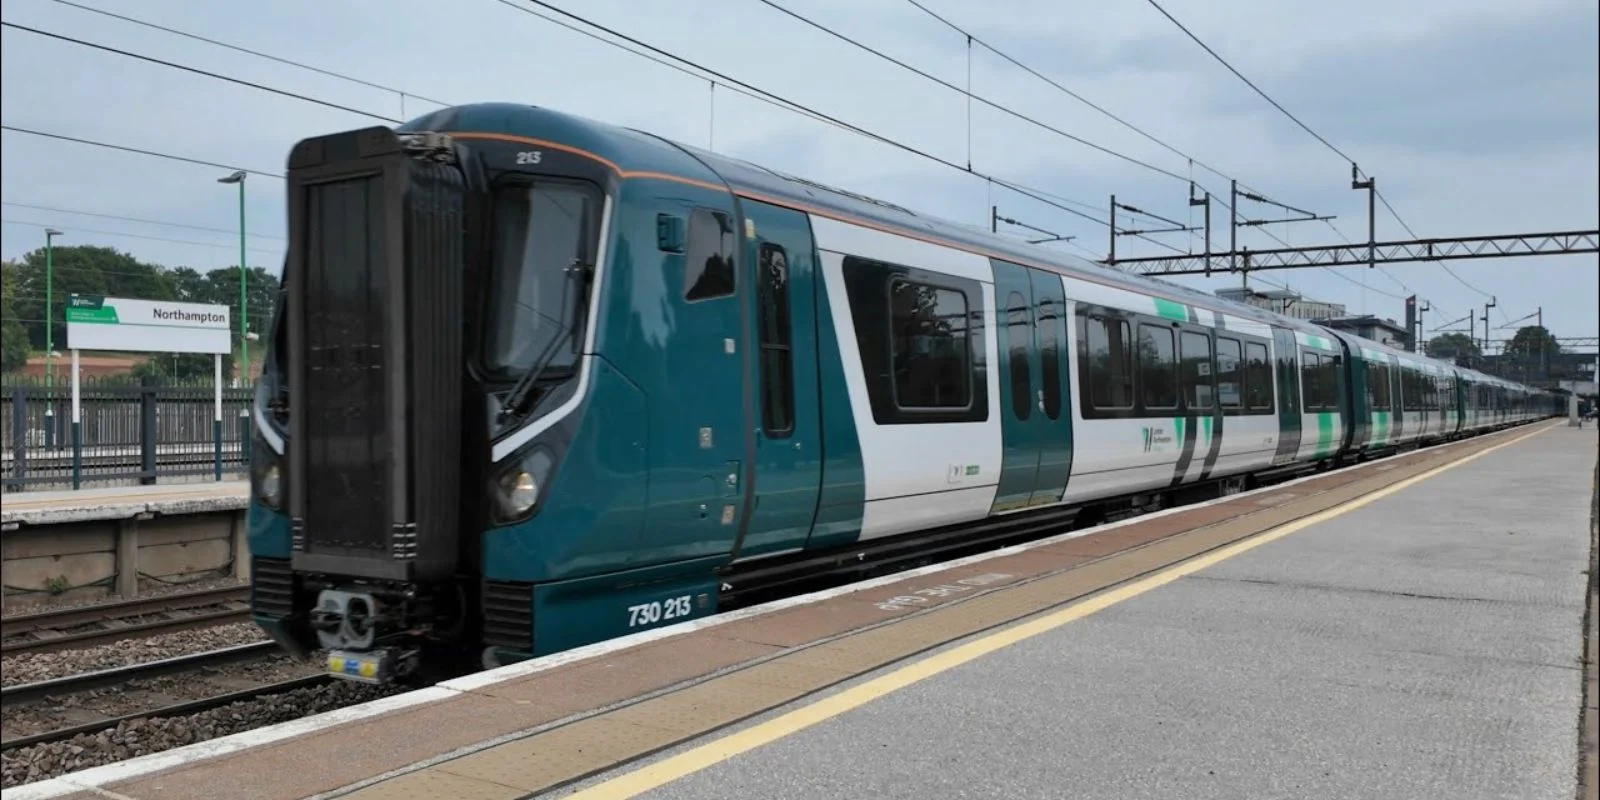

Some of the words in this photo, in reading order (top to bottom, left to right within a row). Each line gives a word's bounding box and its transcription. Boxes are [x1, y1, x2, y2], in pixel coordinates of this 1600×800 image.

[516, 151, 542, 164] 213
[153, 308, 225, 323] Northampton
[628, 601, 661, 627] 730
[664, 595, 691, 619] 213
